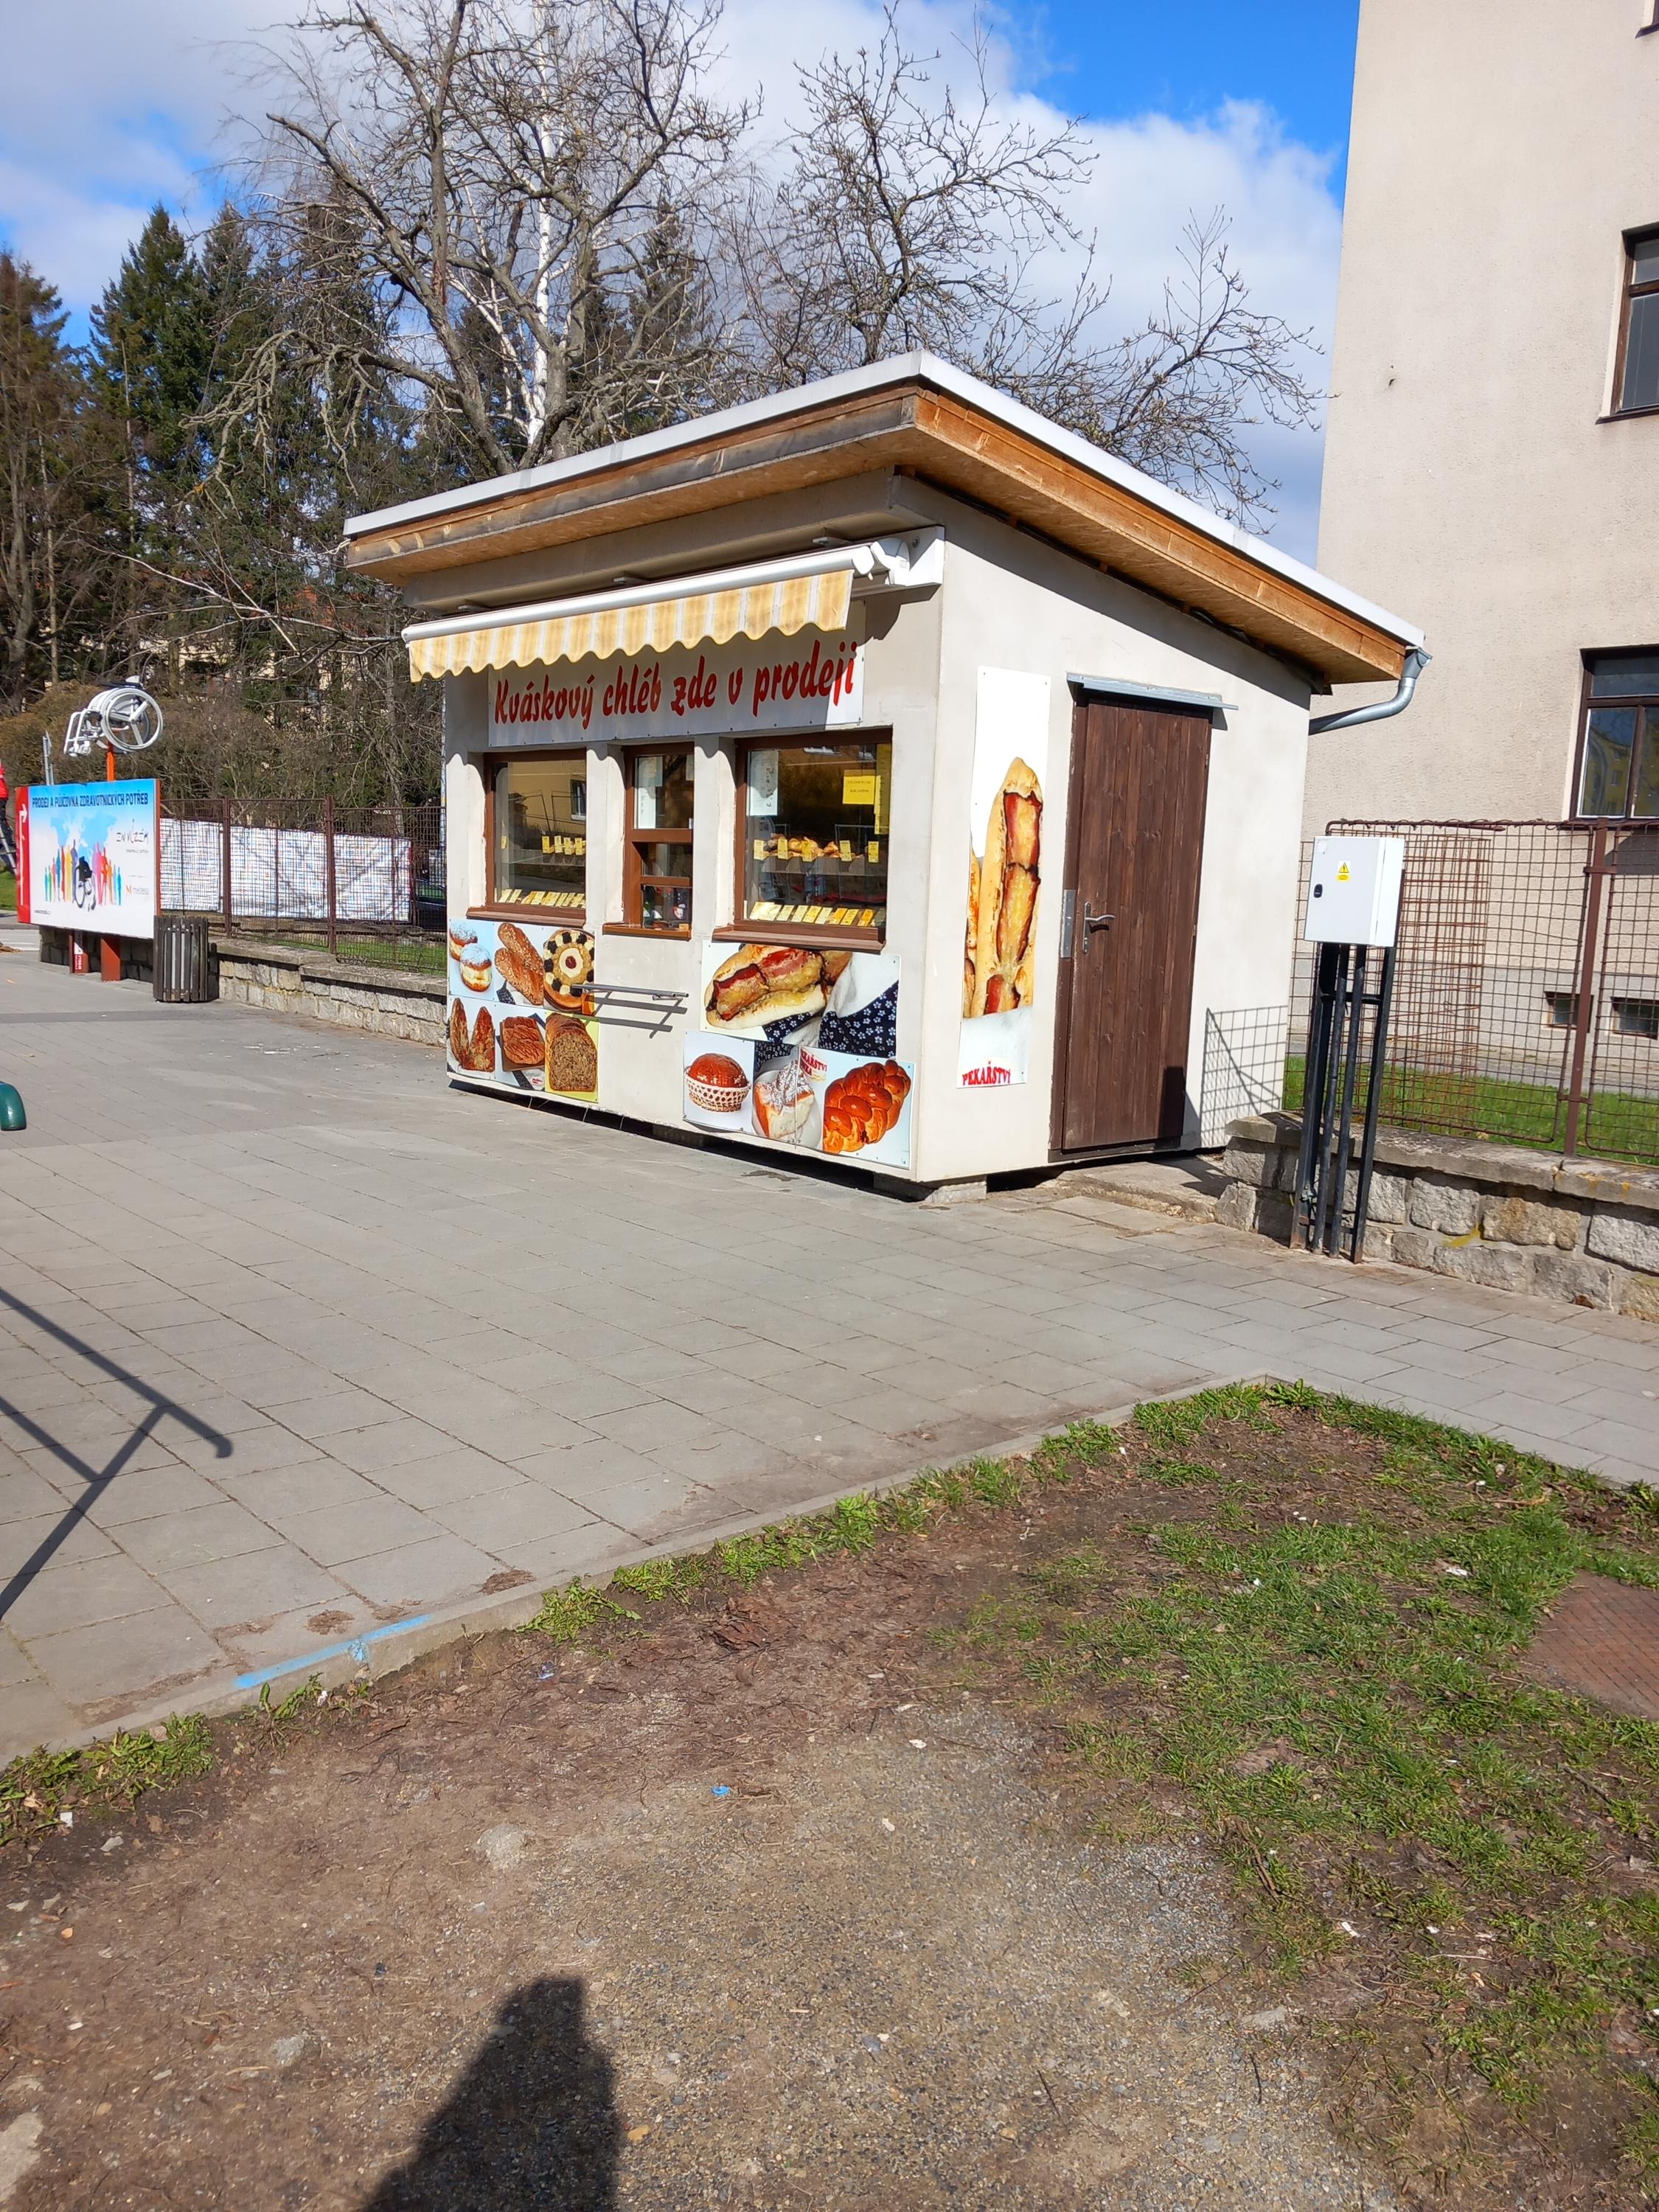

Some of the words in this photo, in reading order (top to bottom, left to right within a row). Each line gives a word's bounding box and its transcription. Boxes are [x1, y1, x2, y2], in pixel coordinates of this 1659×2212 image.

[495, 674, 595, 730] Kváskový
[602, 661, 662, 716] chléb
[670, 654, 716, 717] zde
[728, 667, 743, 706] v
[754, 639, 858, 717] prodeji
[32, 797, 48, 808] PRODEJ
[50, 796, 54, 807] A
[126, 790, 148, 805] POTŘEB
